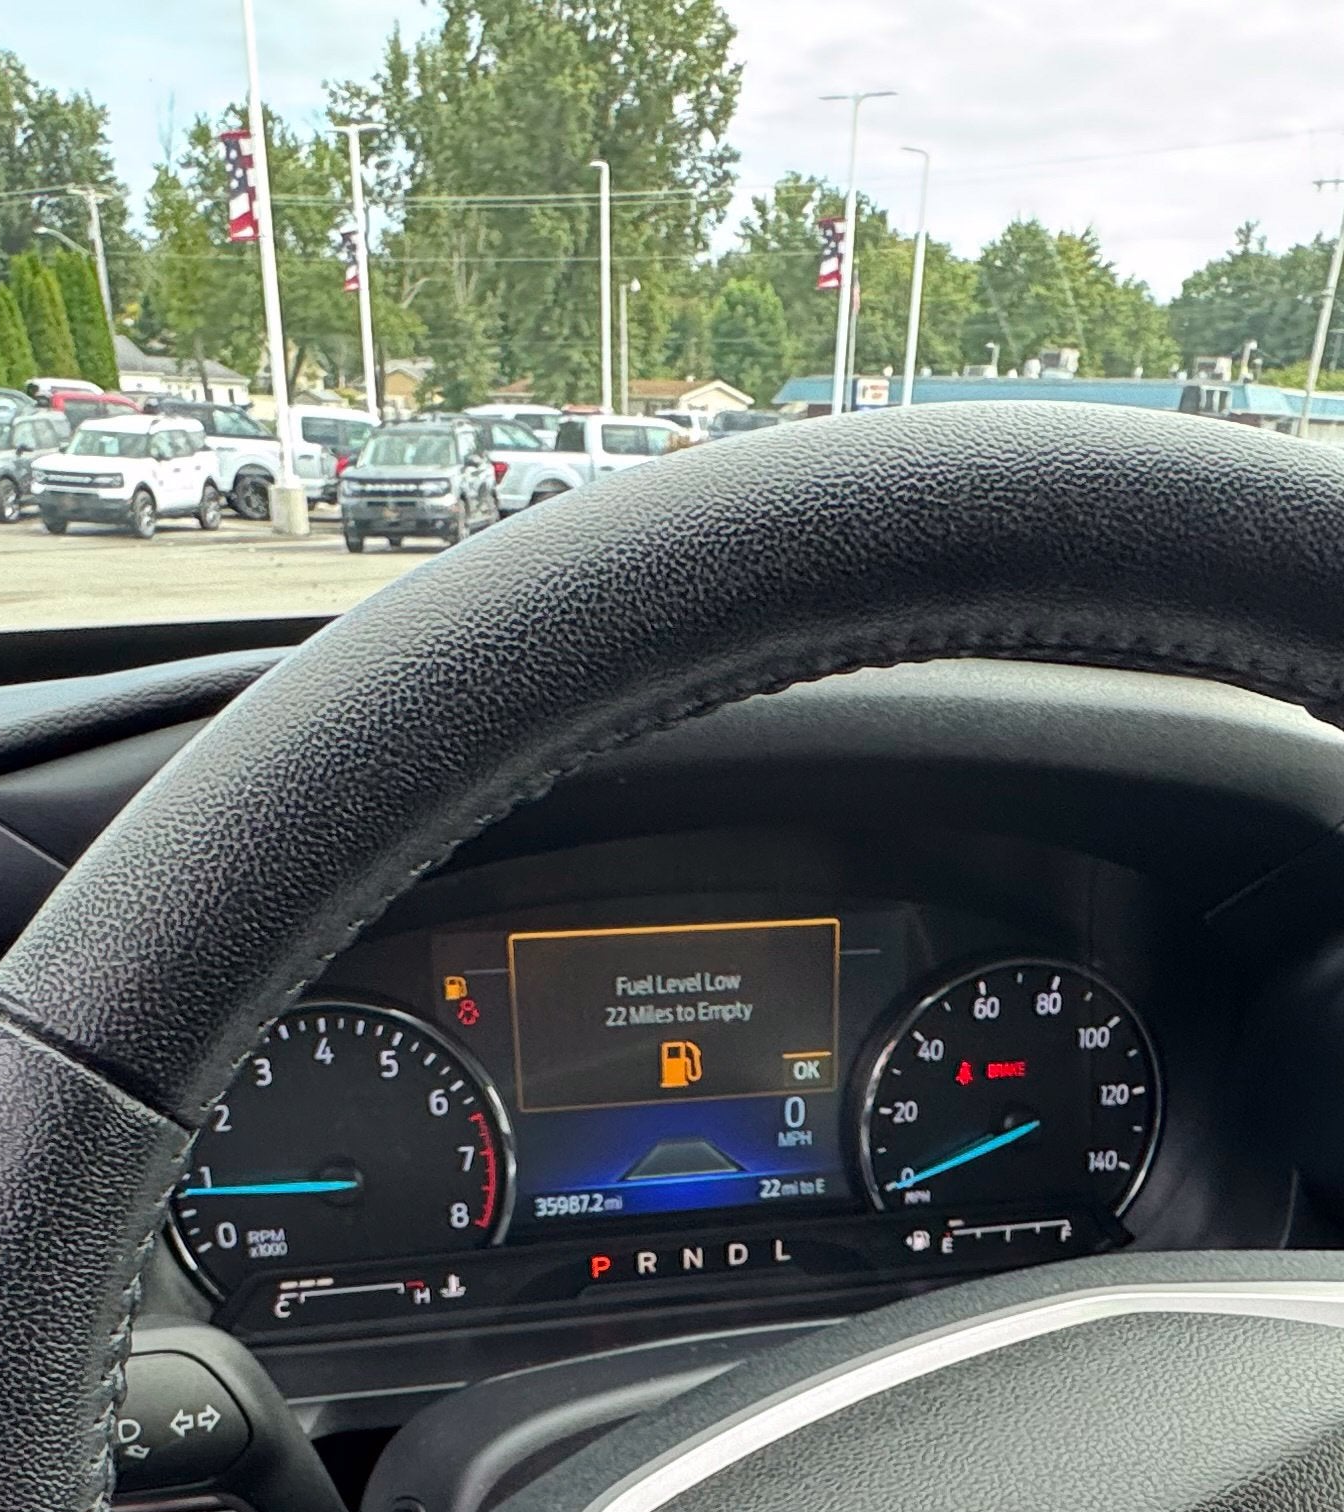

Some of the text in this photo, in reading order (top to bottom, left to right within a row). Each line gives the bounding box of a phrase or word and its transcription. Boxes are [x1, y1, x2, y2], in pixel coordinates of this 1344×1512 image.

[616, 973, 741, 997] Fuel Level Low
[606, 1002, 753, 1027] 22 Miles to Empty
[973, 997, 1000, 1019] 60
[1036, 992, 1062, 1015] 80
[1078, 1027, 1110, 1048] 100
[314, 1037, 335, 1065] 4
[918, 1040, 944, 1061] 40
[253, 1057, 273, 1087] 3
[379, 1050, 400, 1079] 5
[793, 1061, 820, 1080] OK
[428, 1089, 449, 1117] 6
[1100, 1084, 1129, 1105] 120
[214, 1105, 232, 1133] 2
[784, 1096, 806, 1128] 0
[893, 1101, 918, 1123] 20
[778, 1130, 813, 1147] MPH
[457, 1146, 475, 1172] 7
[1088, 1151, 1117, 1172] 140
[200, 1166, 213, 1188] 1
[759, 1178, 825, 1198] 22 mi to E
[450, 1202, 470, 1229] 8
[534, 1194, 623, 1218] 35987.2 mi
[215, 1222, 237, 1249] 0
[247, 1228, 286, 1244] RPM
[1061, 1224, 1072, 1243] F
[942, 1237, 954, 1253] E
[591, 1239, 791, 1279] P R N D L
[413, 1288, 431, 1305] H
[274, 1299, 291, 1318] C
